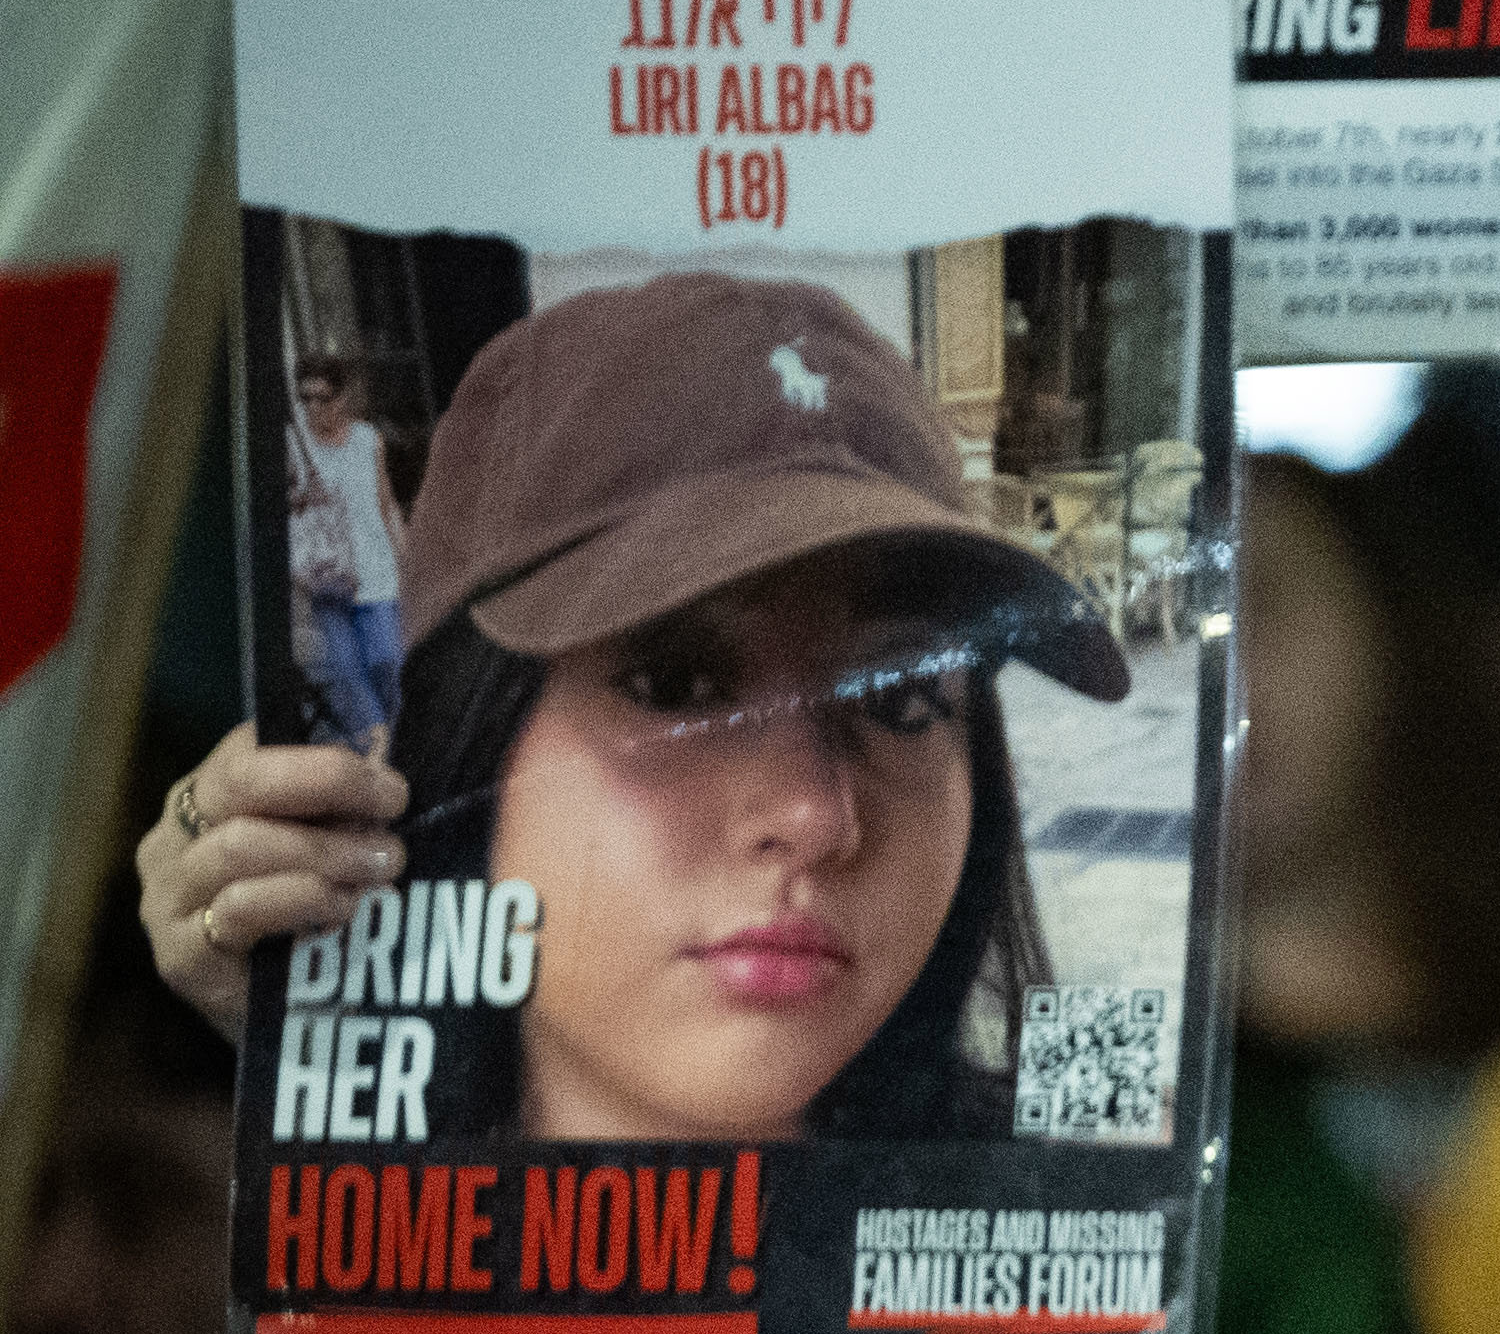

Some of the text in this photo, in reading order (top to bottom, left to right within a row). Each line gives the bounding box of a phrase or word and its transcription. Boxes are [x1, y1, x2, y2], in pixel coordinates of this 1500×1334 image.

[609, 63, 875, 136] LIRI ALBAG
[696, 145, 788, 230] (18)
[1402, 157, 1483, 186] Gaza
[272, 1011, 436, 1142] HER
[266, 1150, 760, 1295] HOME NOW!
[855, 1208, 1166, 1255] HOSTAGES AND MISSING
[852, 1252, 1164, 1317] FAMILIES FORUM
